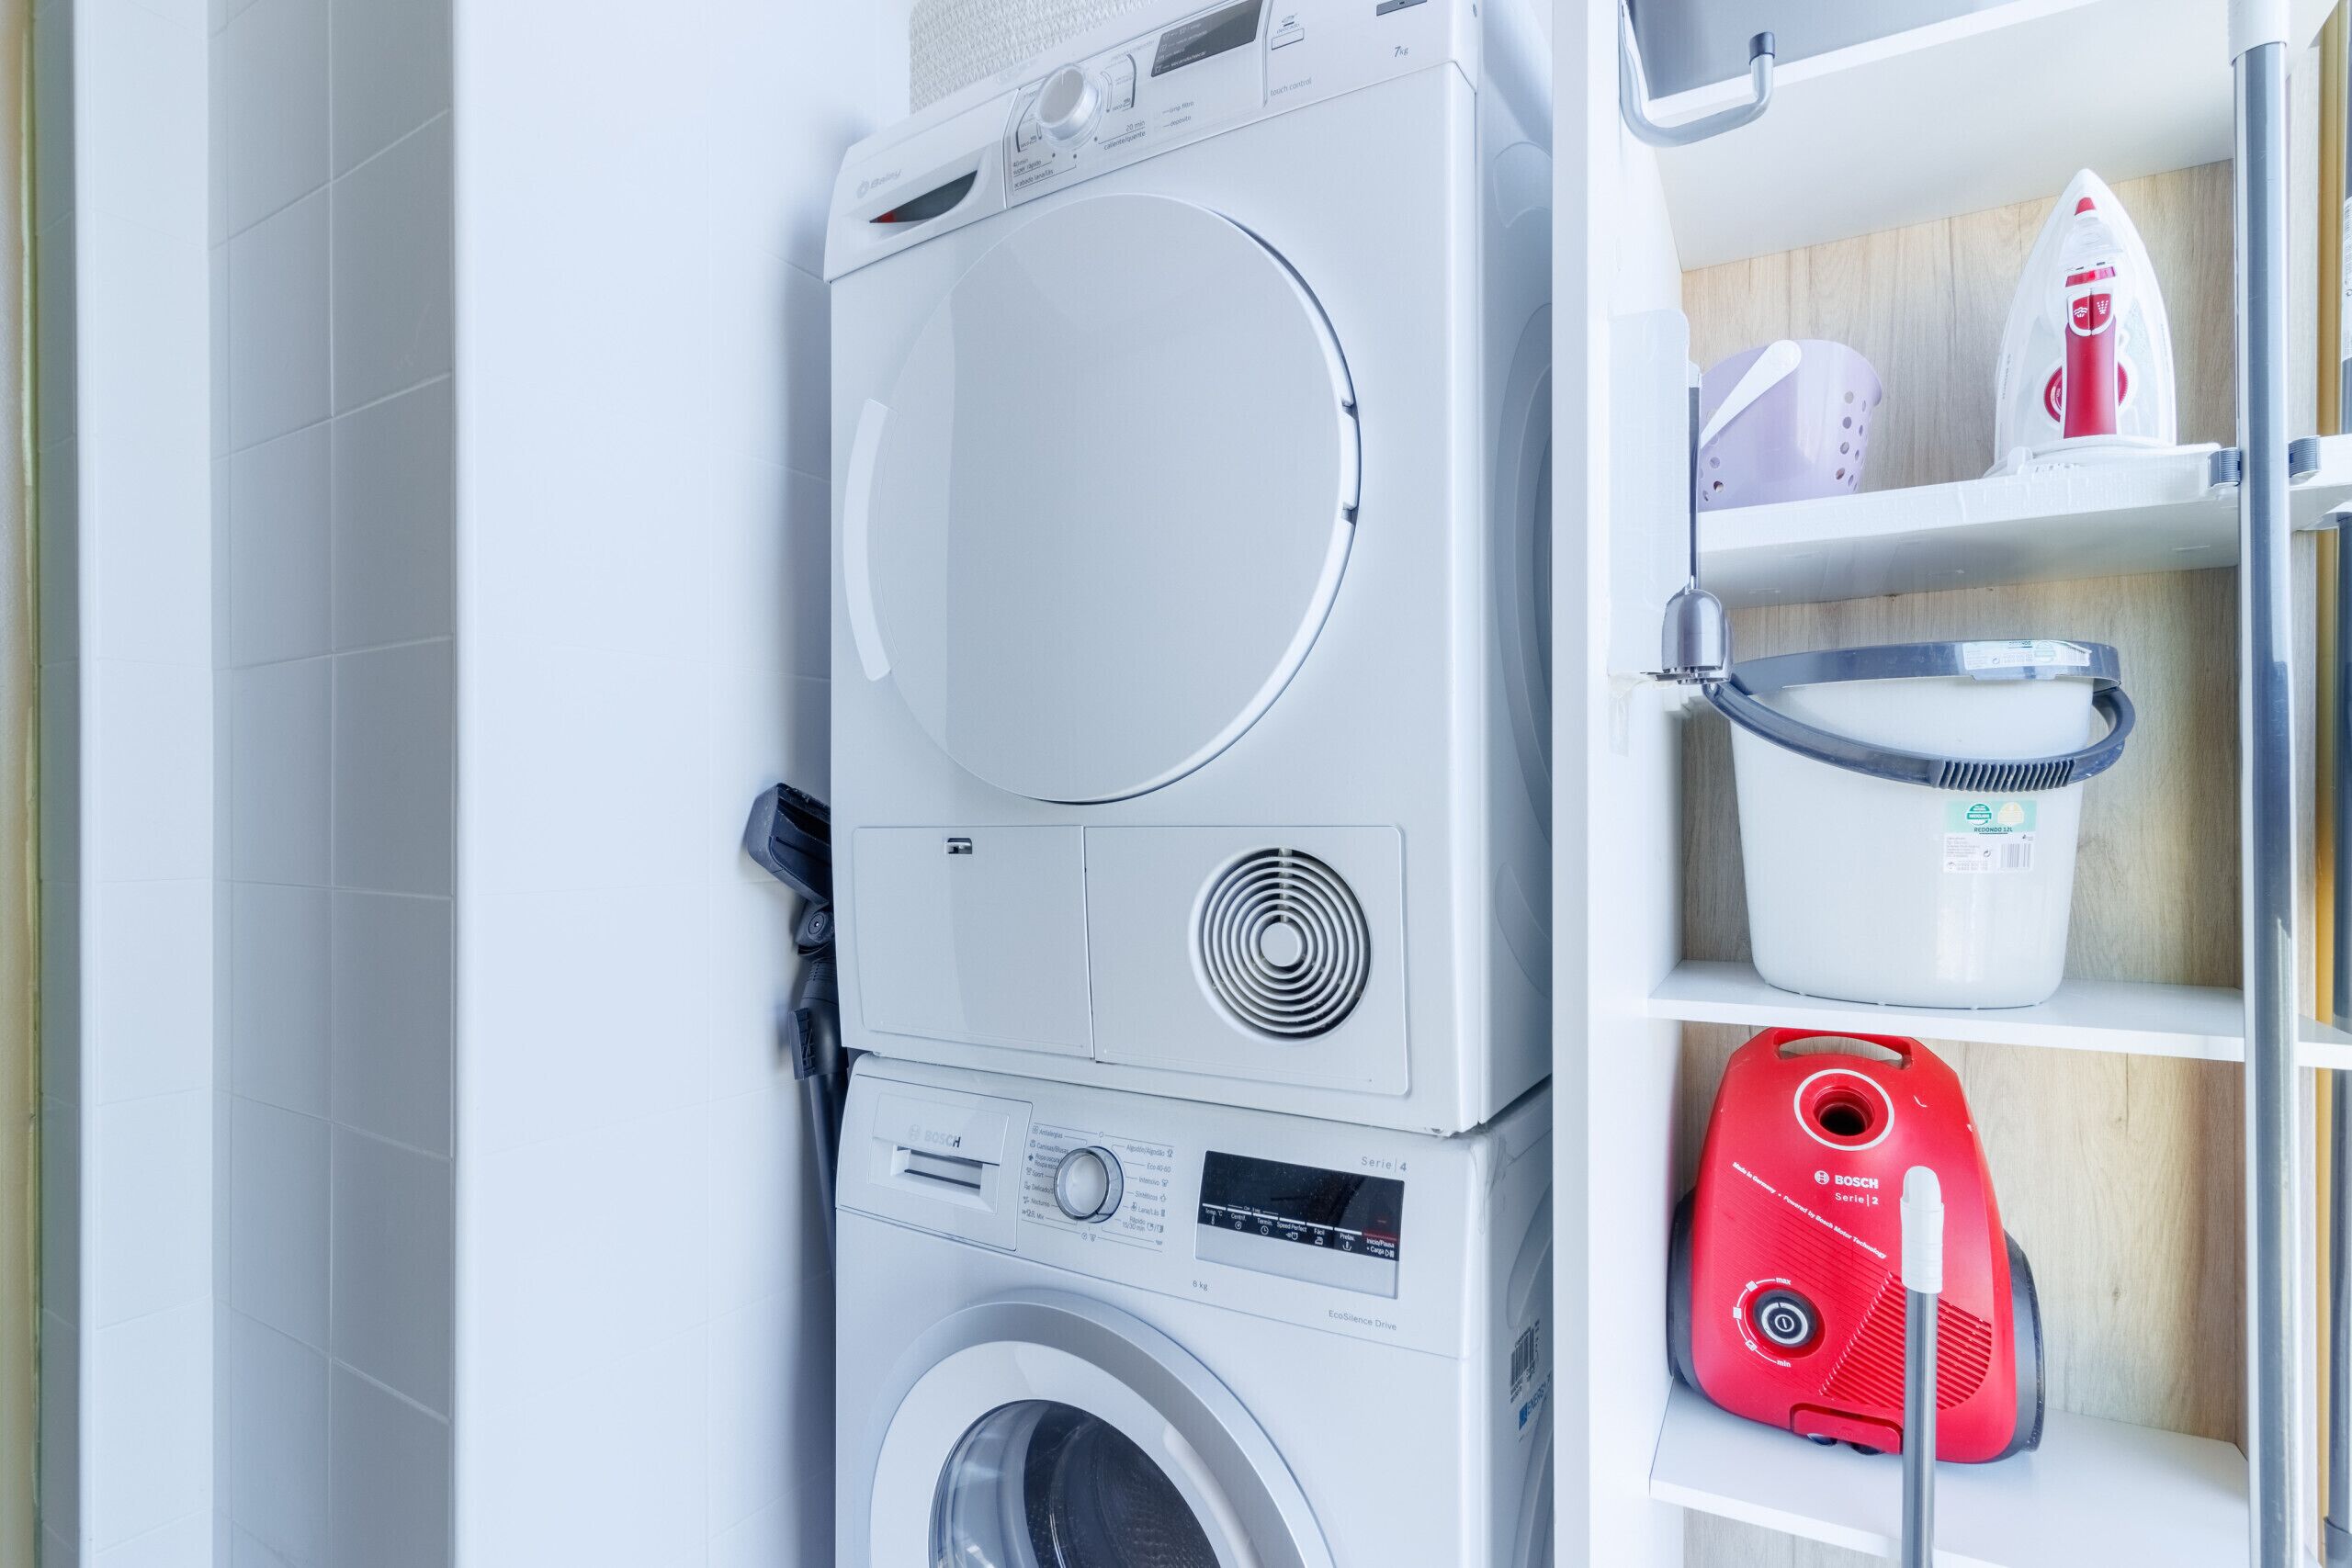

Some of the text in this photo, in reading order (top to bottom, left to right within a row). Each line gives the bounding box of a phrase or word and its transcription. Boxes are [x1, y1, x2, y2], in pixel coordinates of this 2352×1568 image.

[1271, 77, 1312, 96] touch control
[1135, 120, 1146, 130] min
[1104, 131, 1146, 151] caliente/quente
[924, 1131, 961, 1148] BOSCH
[1835, 1174, 1879, 1190] BOSCH
[1733, 1161, 1747, 1175] Made
[1752, 1175, 1777, 1194] Germany
[1782, 1195, 1808, 1213] Powered
[1815, 1214, 1834, 1229] Bosch
[1833, 1225, 1853, 1240] Motor
[1853, 1236, 1886, 1259] Technology
[1277, 1221, 1307, 1233] Speed Perfect
[1366, 1237, 1395, 1248] Inicio/Pausa
[1370, 1246, 1385, 1255] Carga
[1199, 1281, 1208, 1292] kg
[1775, 1277, 1792, 1286] max
[1329, 1310, 1397, 1332] EcoSilence Drive
[1777, 1359, 1792, 1368] min
